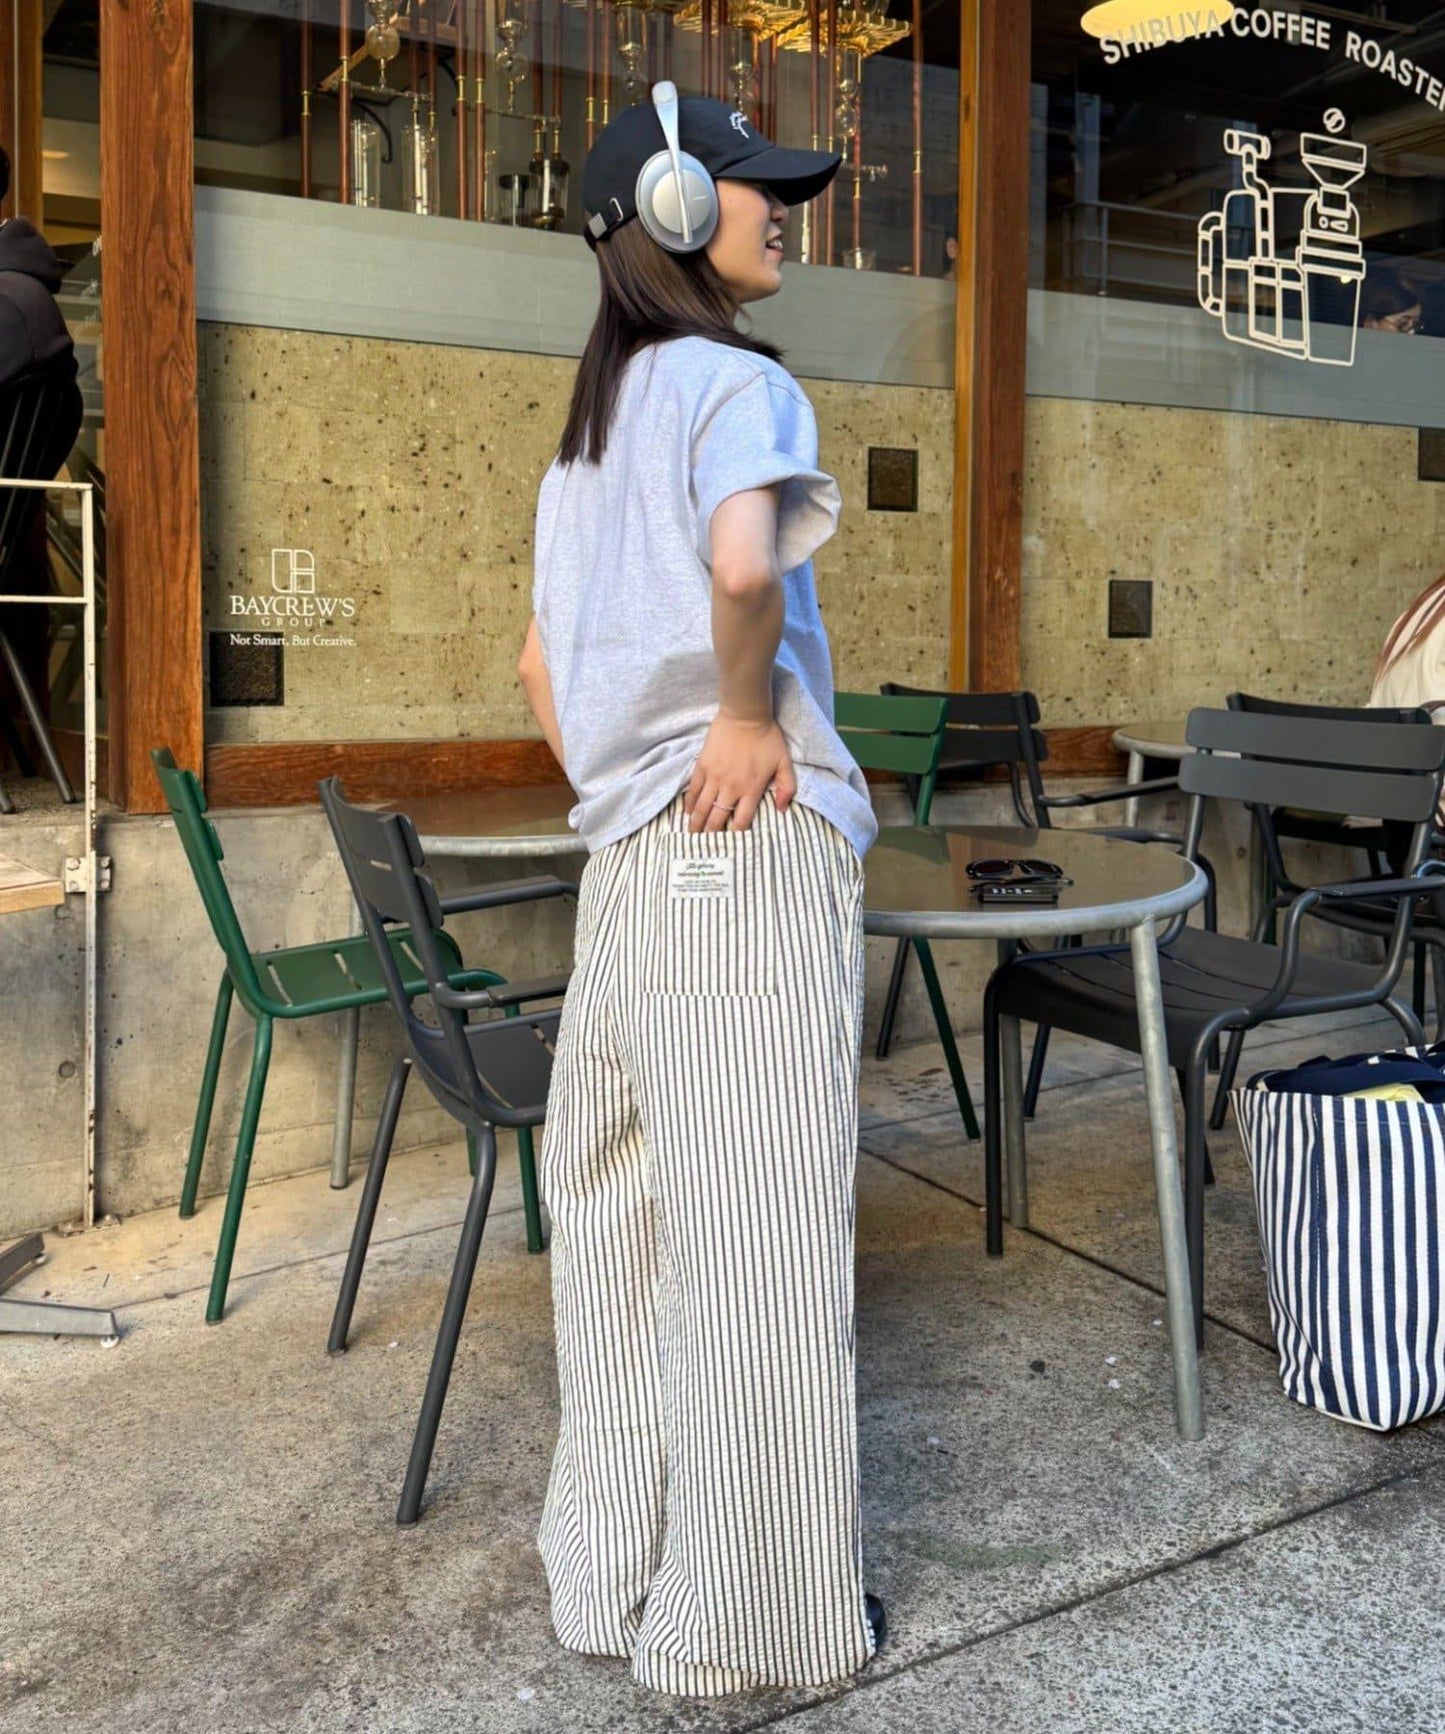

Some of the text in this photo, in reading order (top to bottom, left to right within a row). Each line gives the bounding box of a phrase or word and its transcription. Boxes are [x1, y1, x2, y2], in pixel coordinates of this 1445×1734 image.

[1230, 8, 1331, 51] COFFEE
[230, 595, 356, 617] BAYCREW'S
[261, 617, 325, 627] GROUP
[230, 633, 250, 646] Not
[292, 635, 310, 646] But
[313, 635, 357, 646] Creative.
